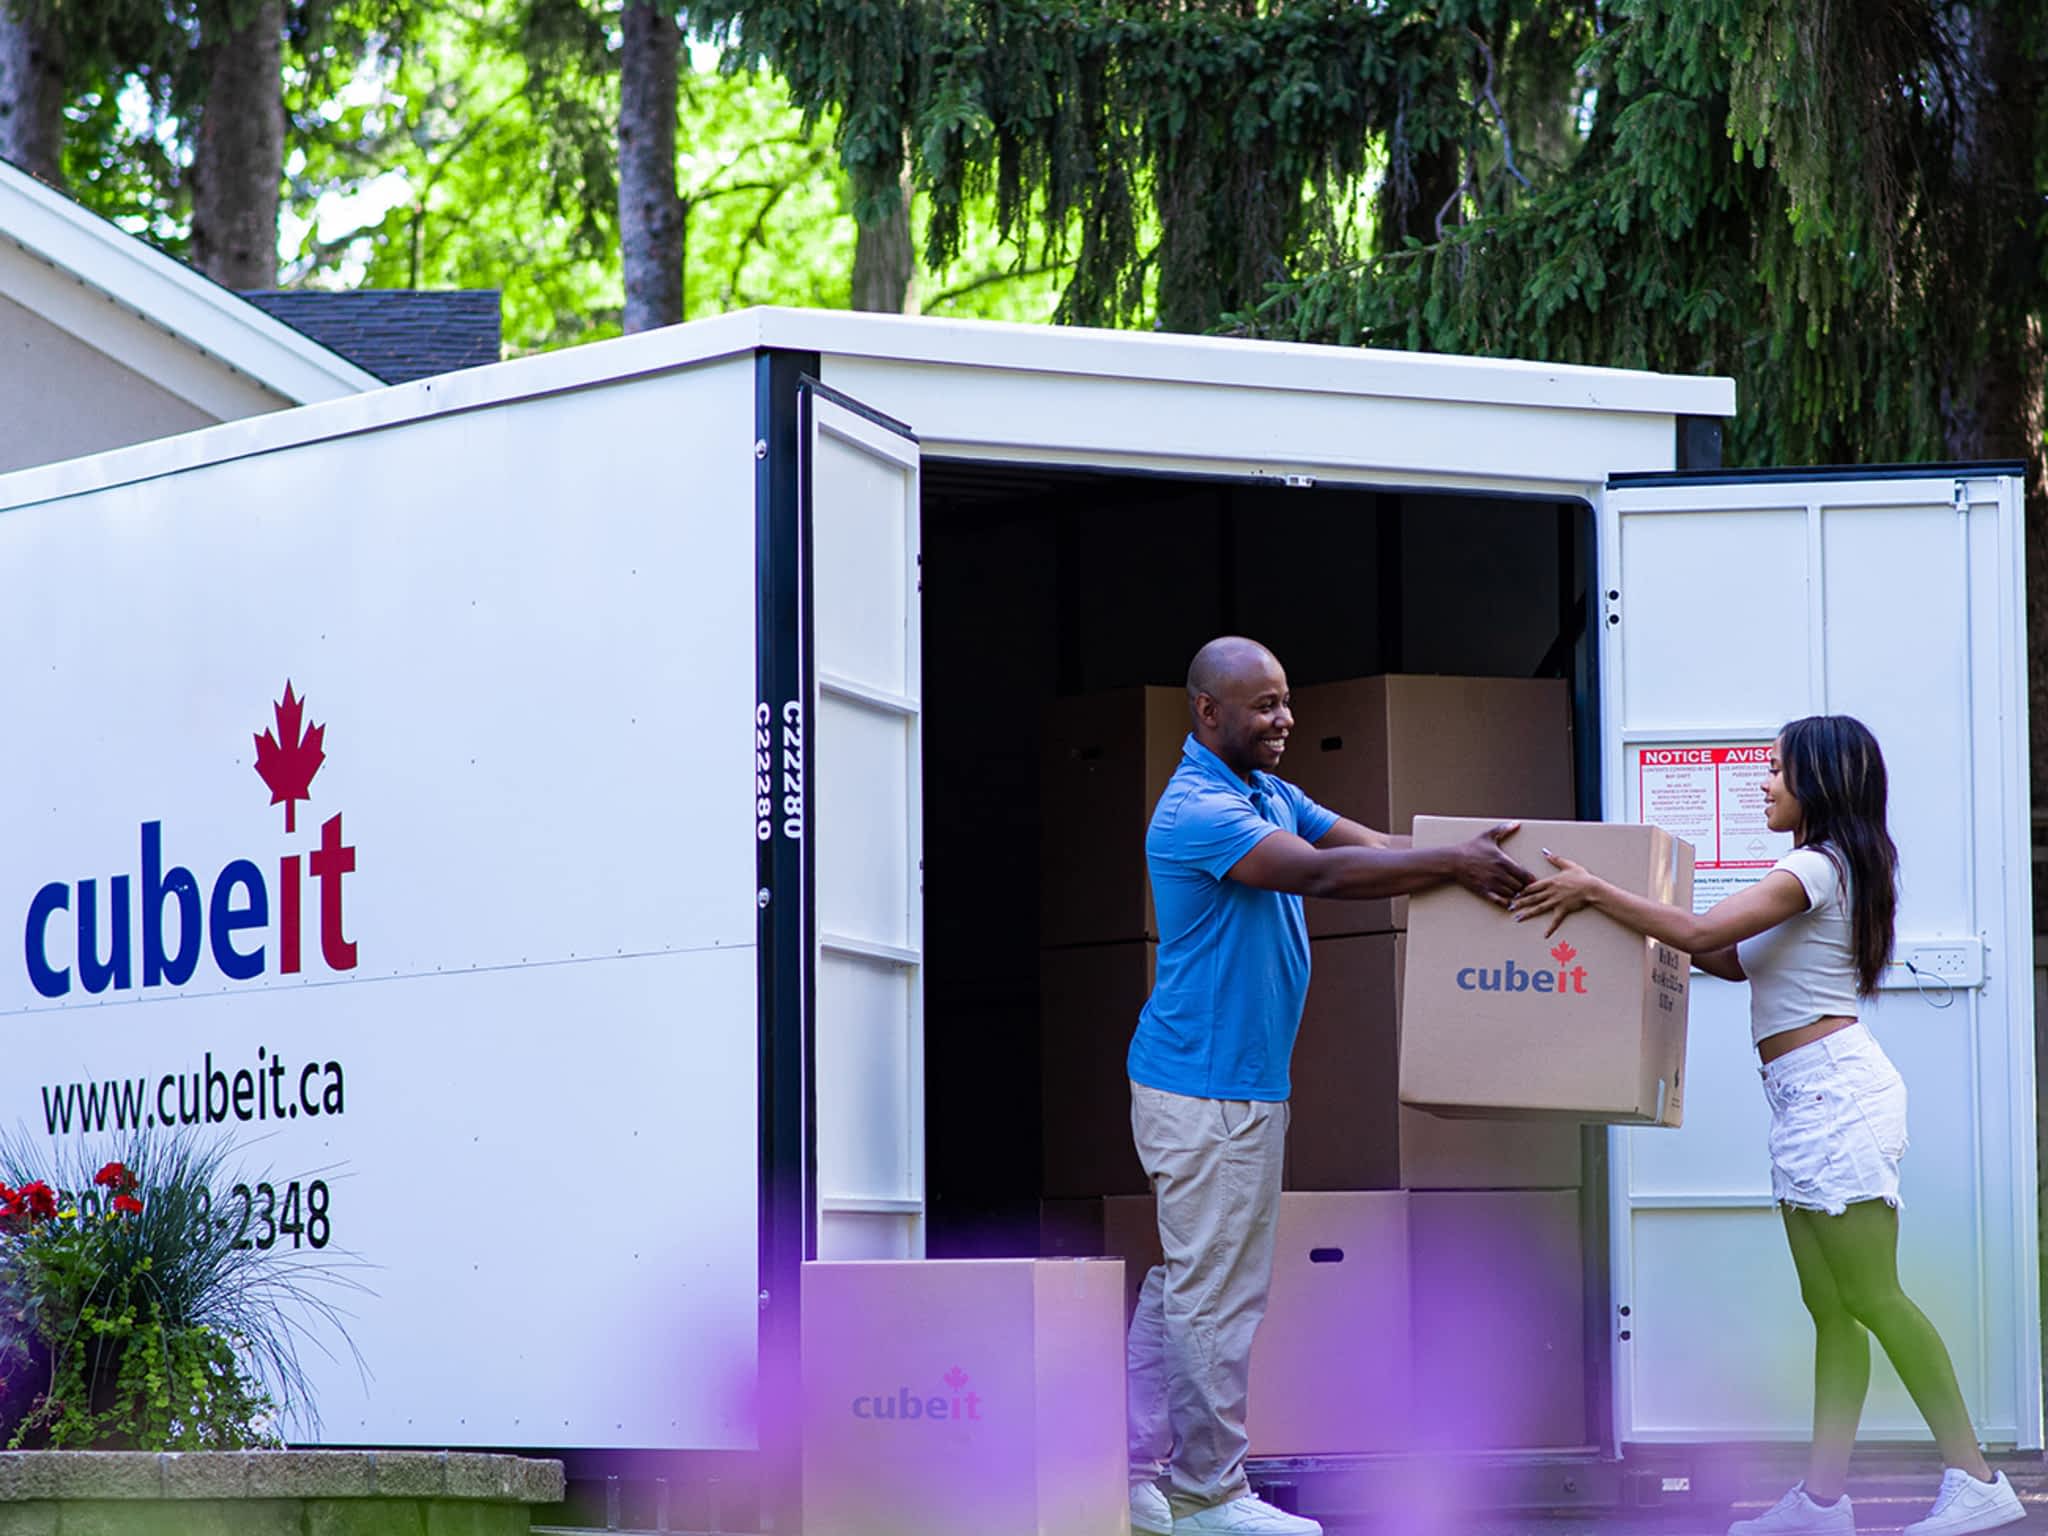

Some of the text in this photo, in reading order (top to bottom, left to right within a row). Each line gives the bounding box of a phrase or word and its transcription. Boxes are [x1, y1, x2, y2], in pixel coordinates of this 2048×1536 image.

[757, 702, 771, 840] C22280
[783, 700, 803, 839] C22280
[1645, 750, 1712, 763] NOTICE
[25, 811, 358, 998] cubeit
[1456, 960, 1588, 994] cubeit
[41, 1046, 345, 1136] www.cubeit.ca
[852, 1386, 982, 1421] cubeit
